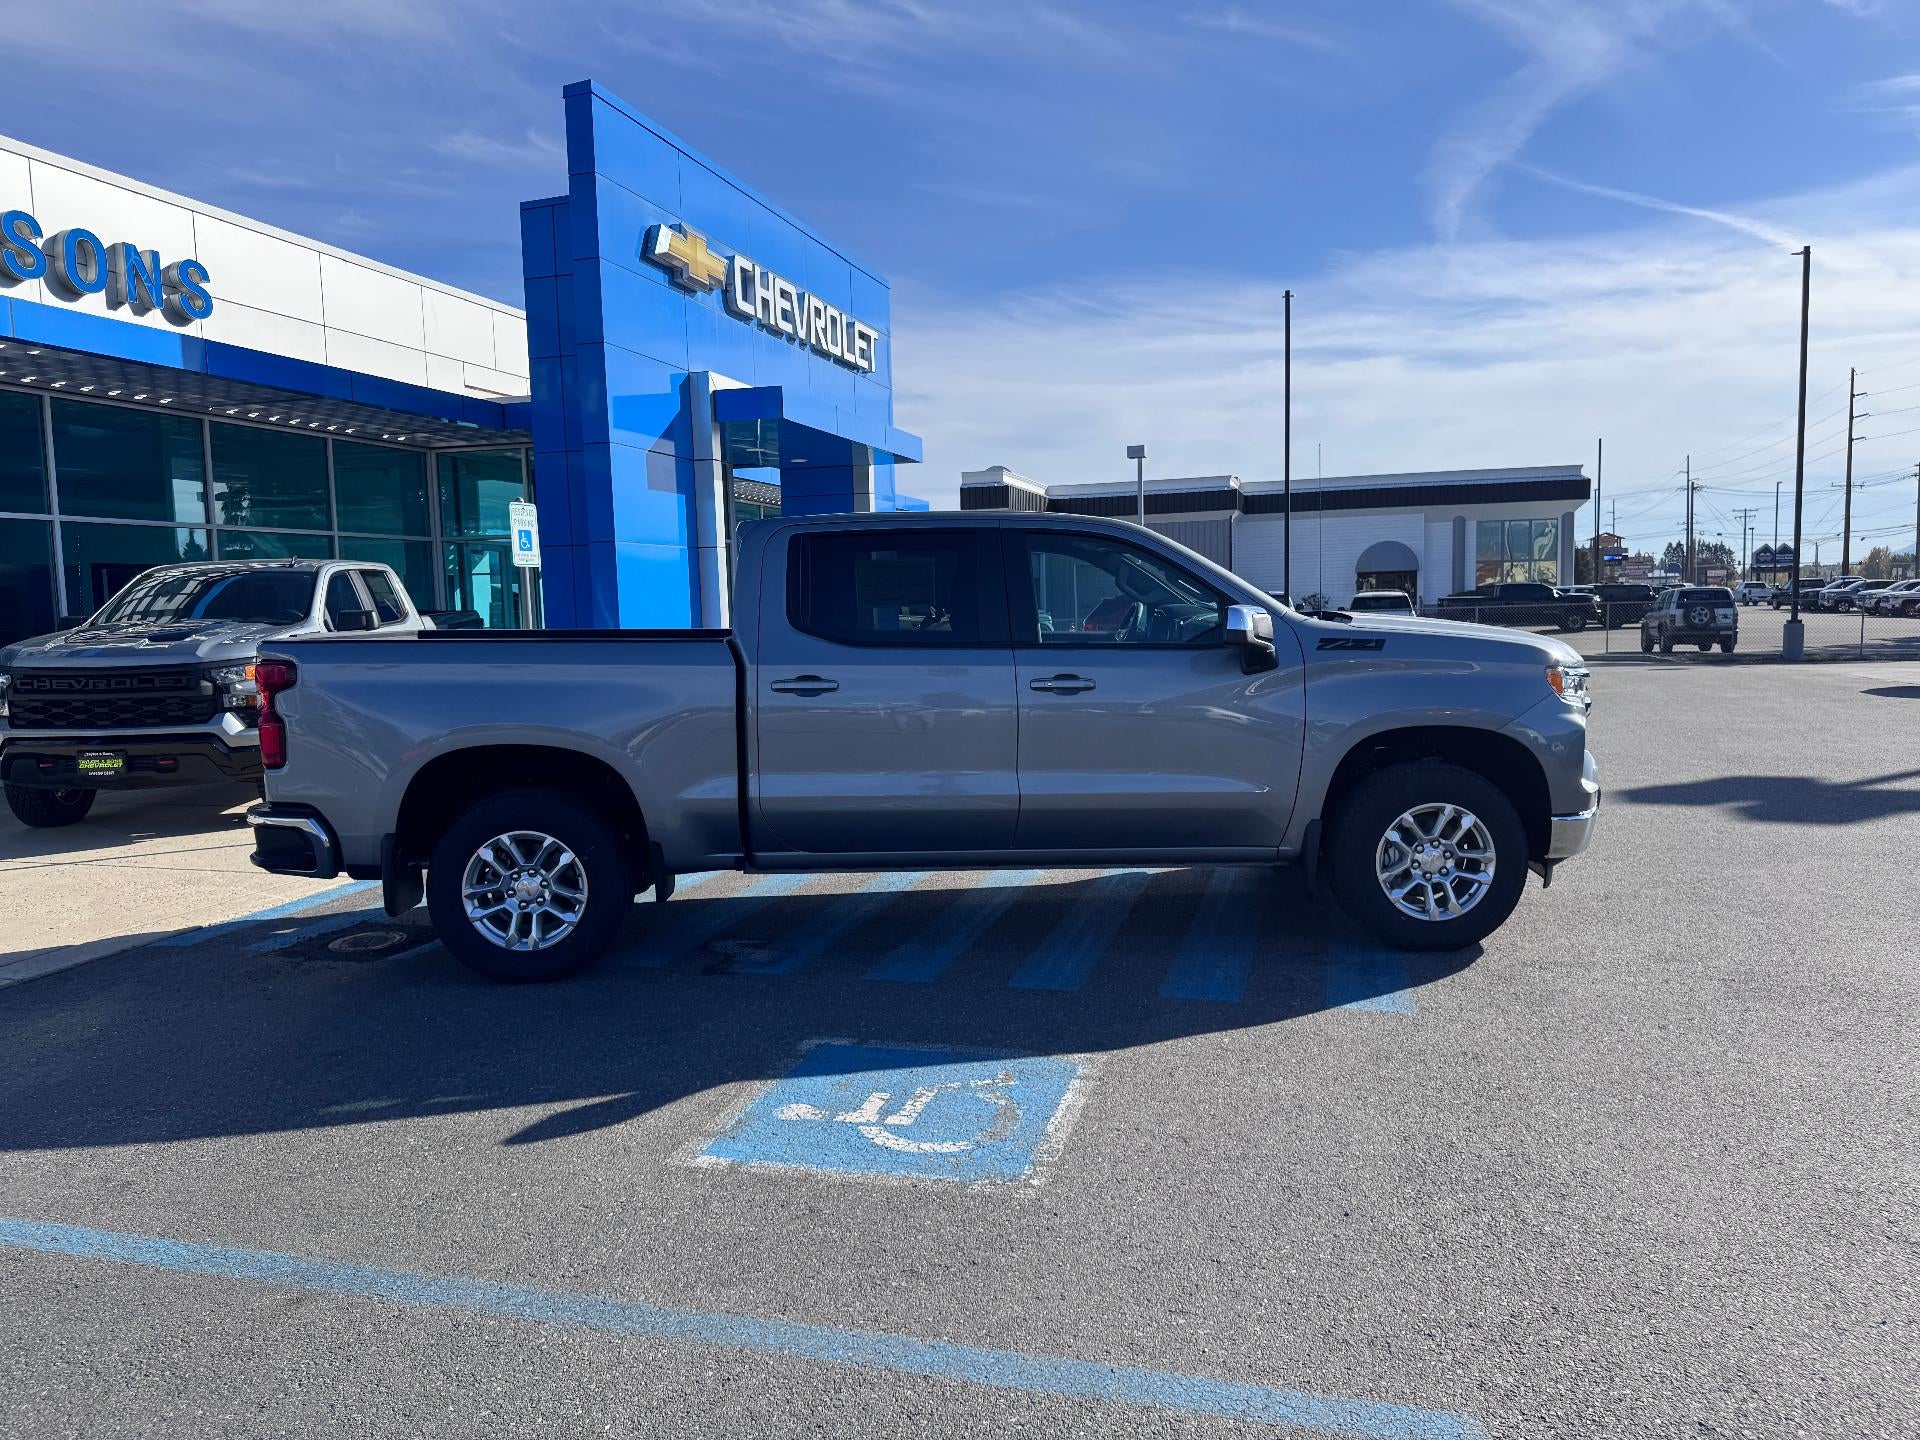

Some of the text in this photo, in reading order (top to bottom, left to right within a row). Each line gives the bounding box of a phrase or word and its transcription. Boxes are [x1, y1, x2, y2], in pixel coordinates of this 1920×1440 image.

[0, 209, 213, 321] SONS
[733, 254, 878, 373] CHEVROLET
[16, 675, 187, 689] CHEVROLET
